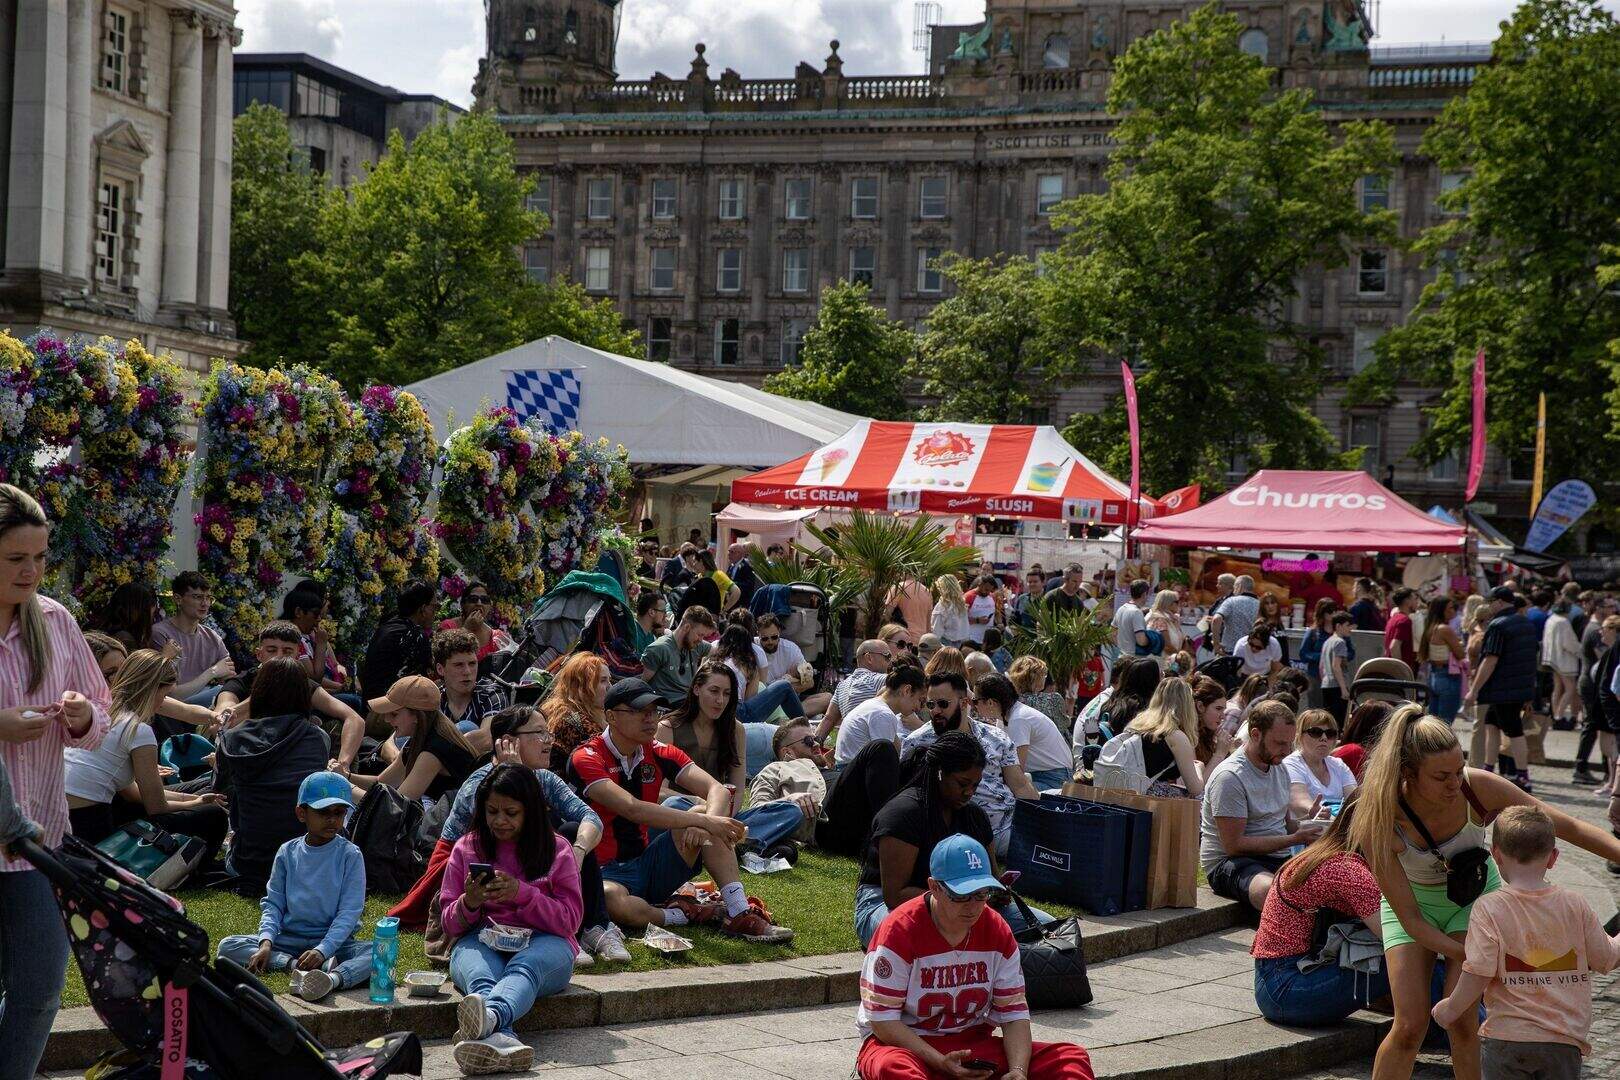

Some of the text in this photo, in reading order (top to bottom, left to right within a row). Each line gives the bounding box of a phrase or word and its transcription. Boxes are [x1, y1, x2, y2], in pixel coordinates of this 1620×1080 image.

[995, 133, 1120, 149] SCOTTISH PRO
[784, 488, 807, 500] ICE
[809, 489, 859, 502] CREAM
[1228, 485, 1387, 511] Churros
[985, 499, 1034, 512] SLUSH
[964, 850, 983, 870] LA
[1500, 976, 1552, 986] UNSHINE
[169, 997, 183, 1063] COSATTO
